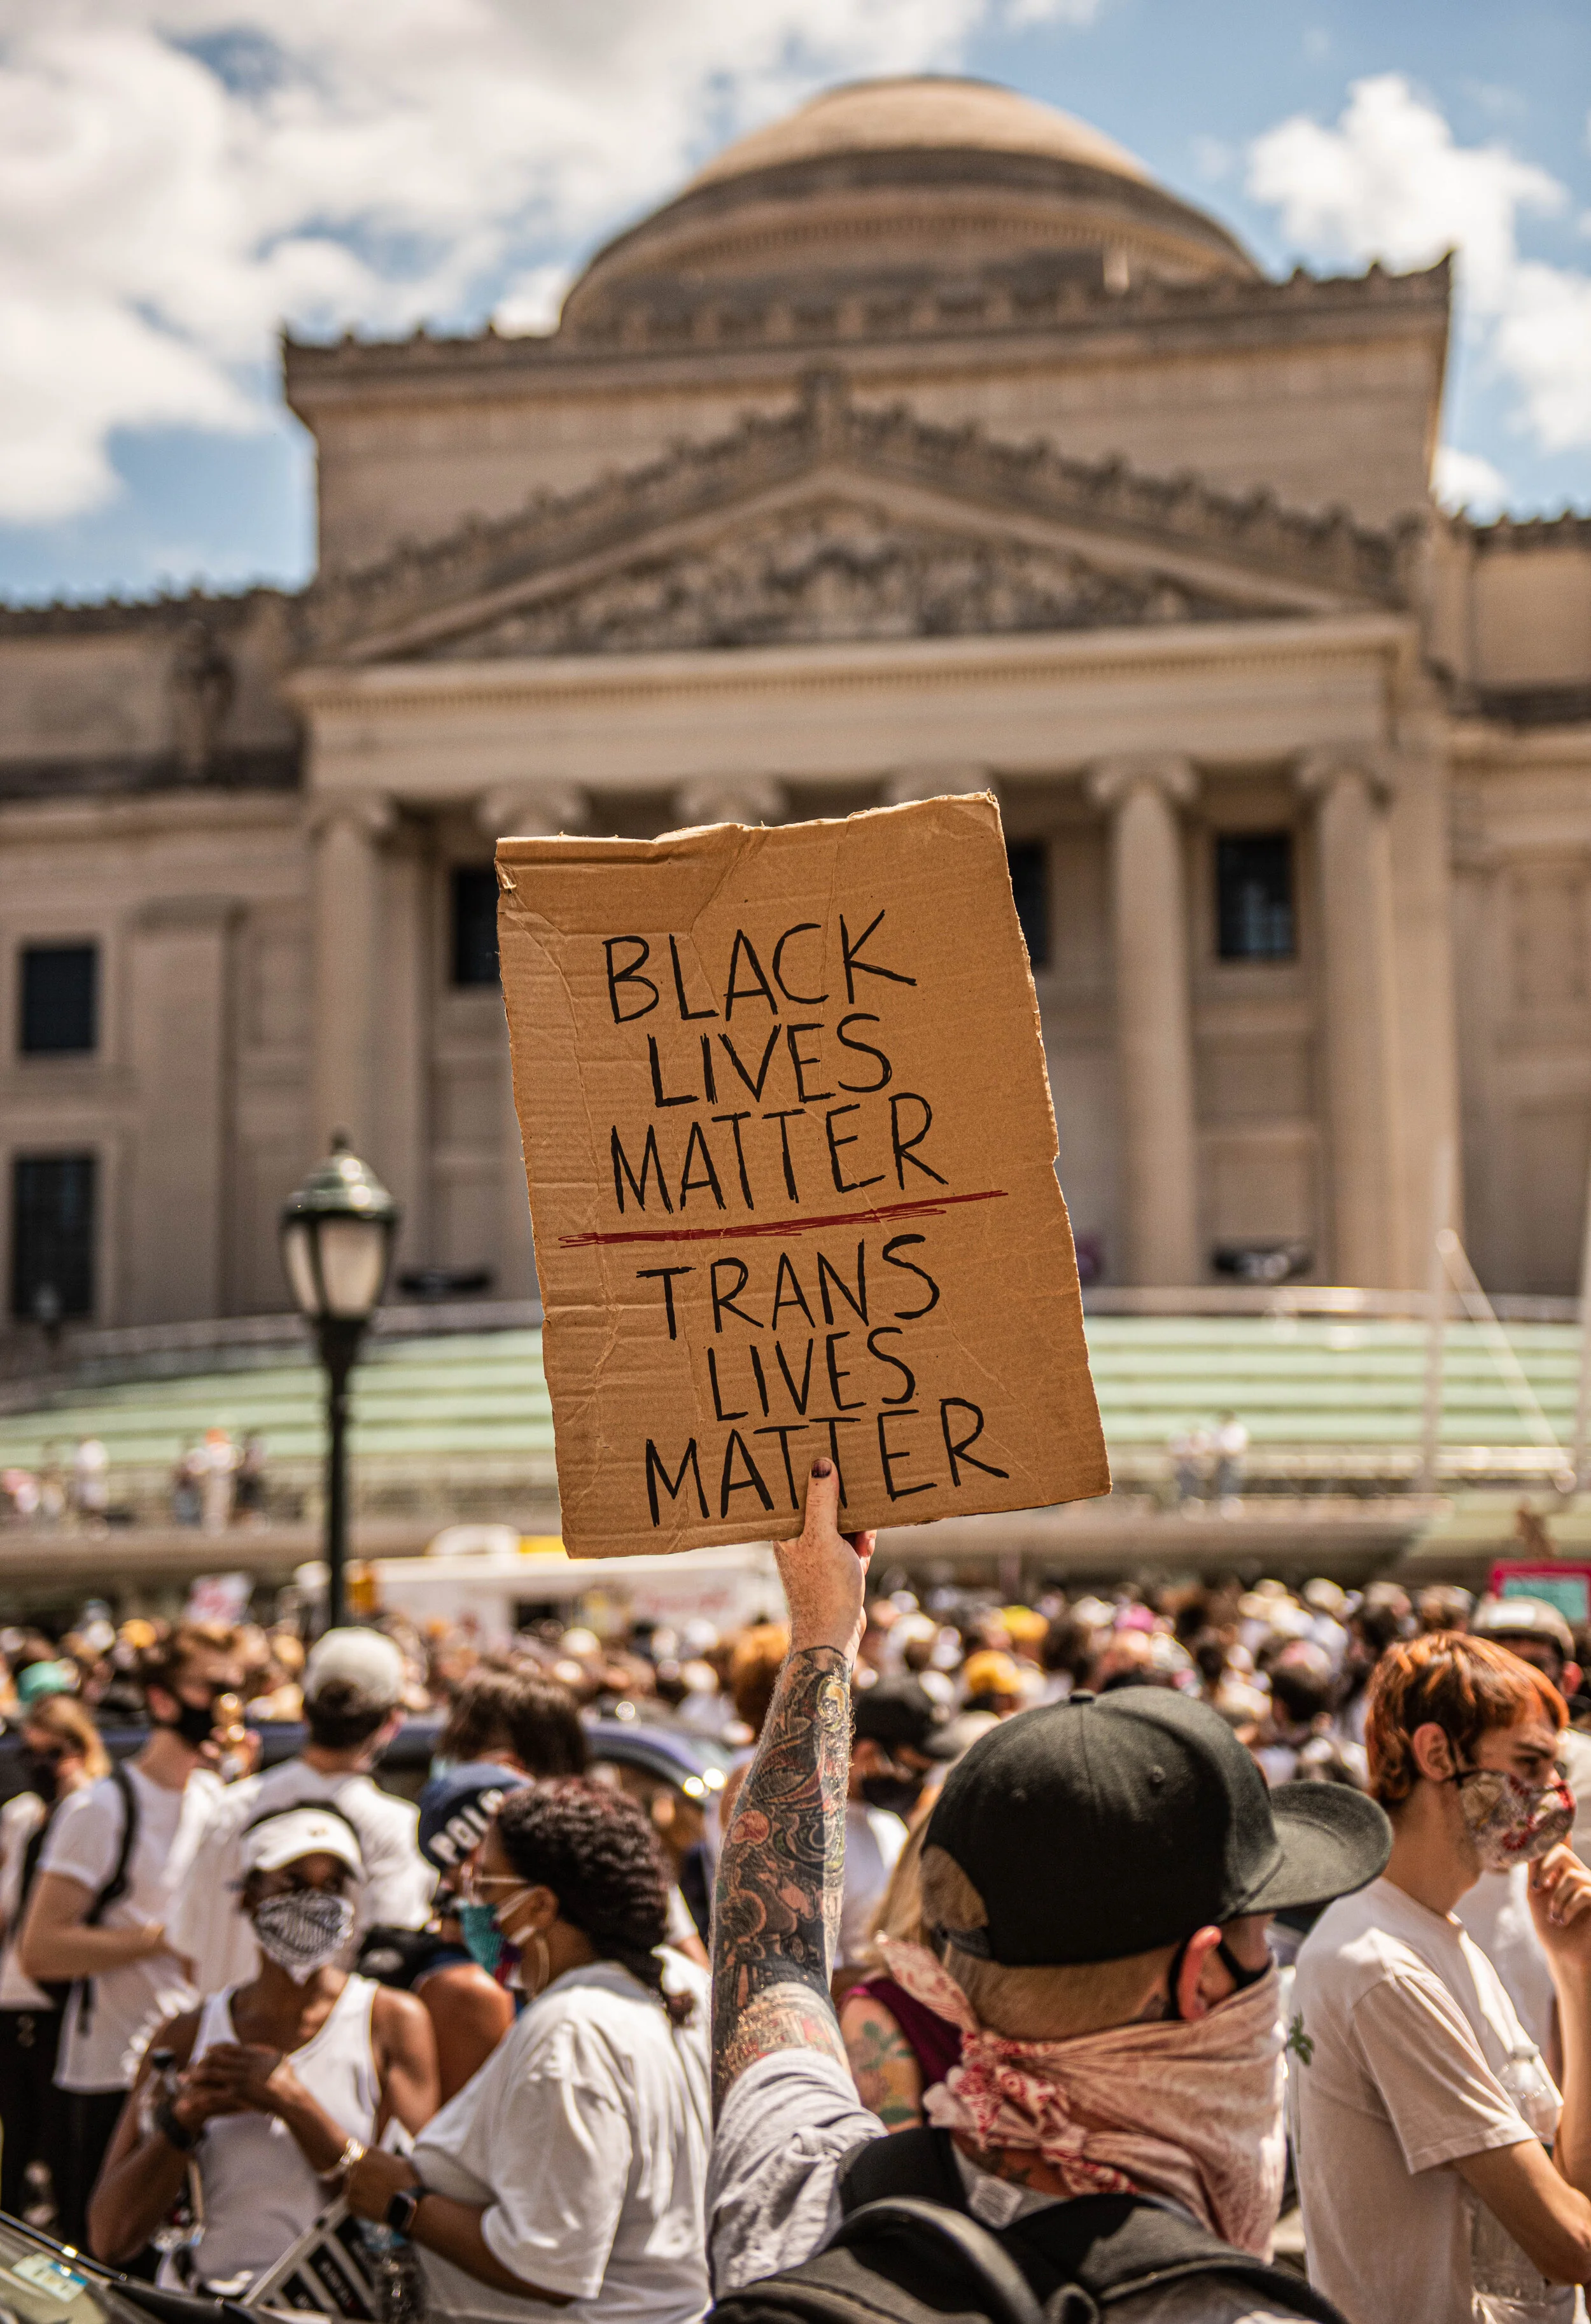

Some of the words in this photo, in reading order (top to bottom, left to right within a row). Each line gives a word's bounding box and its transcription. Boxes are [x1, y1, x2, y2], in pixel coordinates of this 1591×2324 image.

[601, 909, 918, 1025] BLACK
[647, 1012, 893, 1108] LIVES
[610, 1092, 950, 1215] MATTER
[636, 1233, 941, 1341] TRANS
[707, 1326, 916, 1422] LIVES
[645, 1397, 1010, 1528] MATTER
